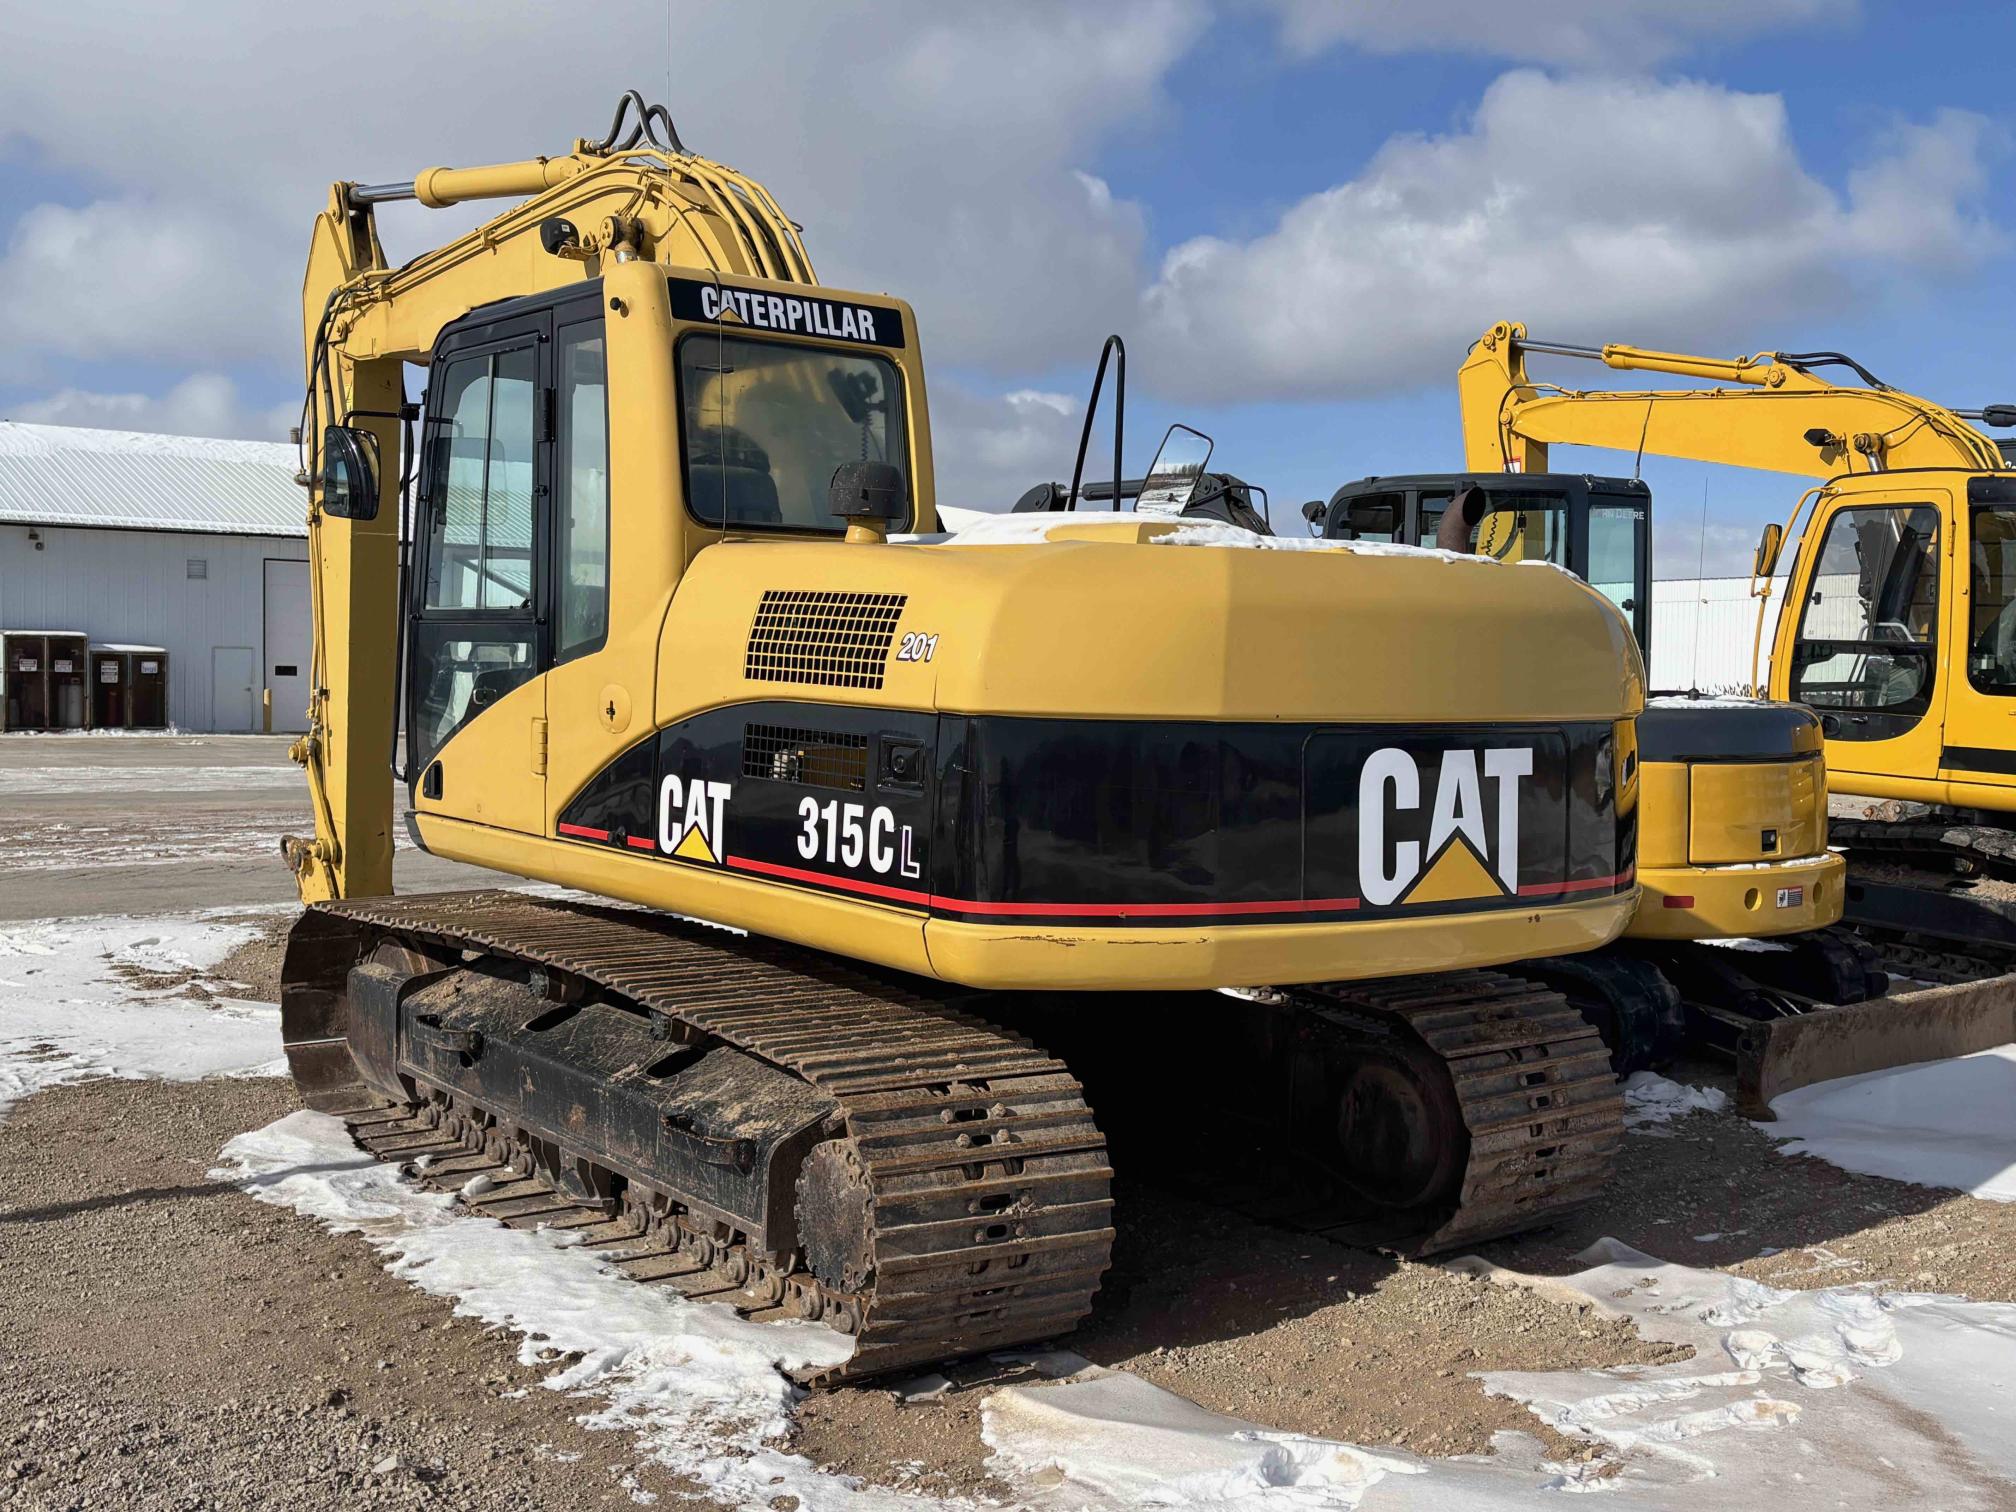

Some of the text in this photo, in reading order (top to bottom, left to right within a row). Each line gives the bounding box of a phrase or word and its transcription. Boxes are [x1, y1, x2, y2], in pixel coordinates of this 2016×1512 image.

[700, 286, 877, 342] CATERPILLAR
[896, 631, 940, 663] 201
[659, 774, 732, 864] CAT
[1358, 747, 1534, 906] CAT
